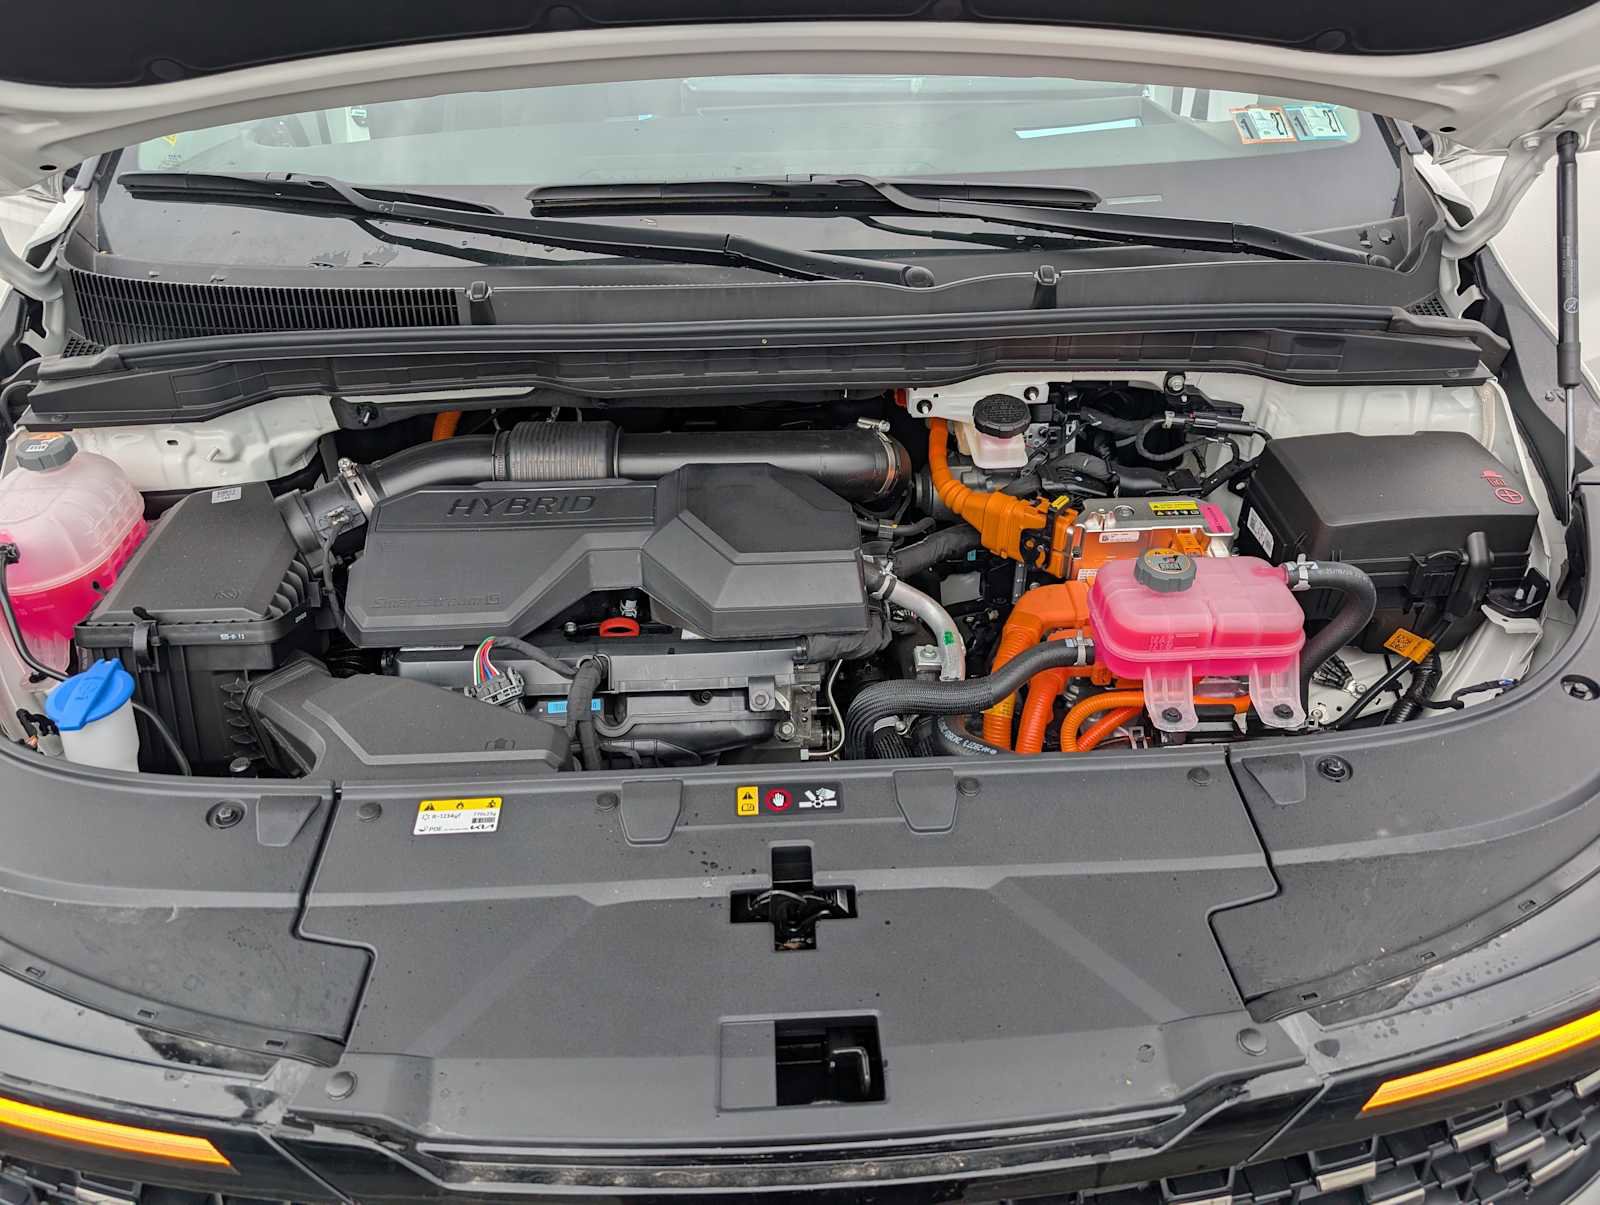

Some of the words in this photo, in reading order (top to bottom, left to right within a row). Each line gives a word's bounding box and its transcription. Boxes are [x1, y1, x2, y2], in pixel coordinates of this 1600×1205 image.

[1270, 112, 1288, 136] 27
[1322, 110, 1342, 132] 27
[447, 495, 597, 517] HYBRID
